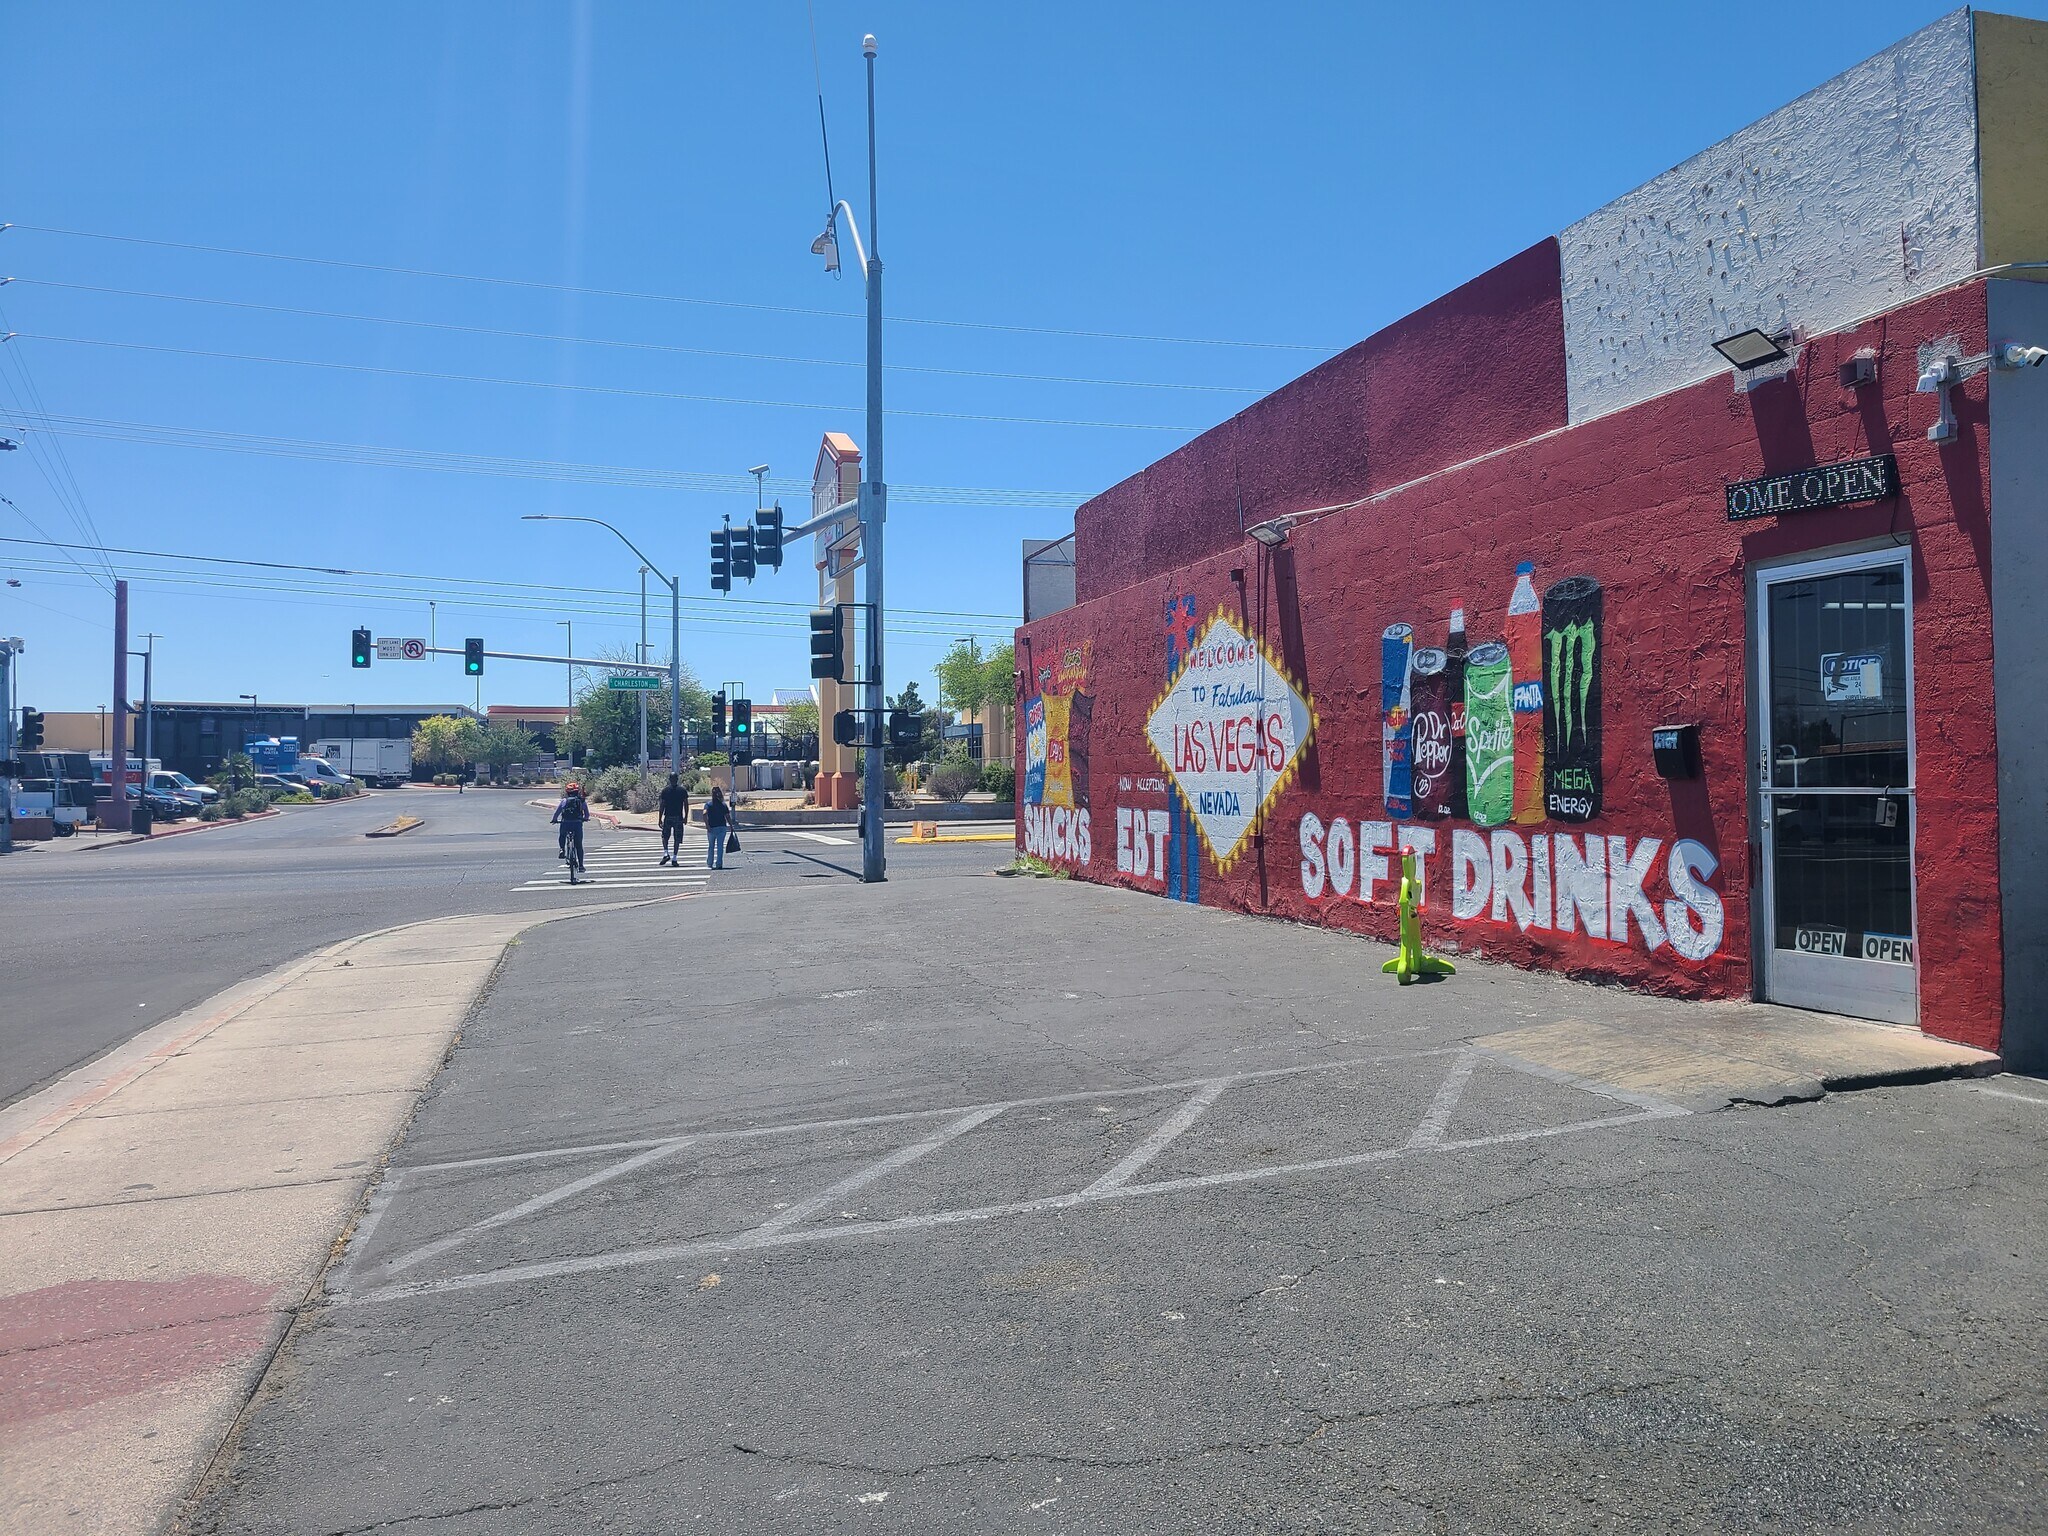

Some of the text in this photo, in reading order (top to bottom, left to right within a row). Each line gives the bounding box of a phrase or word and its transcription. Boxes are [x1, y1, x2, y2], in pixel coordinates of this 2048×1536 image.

[1732, 464, 1884, 513] OME OPEN
[1190, 644, 1255, 669] WELCOME
[613, 679, 649, 688] CHARLESTON
[1192, 686, 1206, 703] TO
[1514, 684, 1542, 711] FANTA
[1428, 711, 1447, 740] Dr
[1174, 713, 1285, 774] LAS VEGAS
[1411, 713, 1450, 769] Pepper
[1467, 716, 1512, 764] Sprite
[1119, 776, 1132, 792] NOW
[1553, 768, 1594, 793] MEGA
[1199, 791, 1241, 816] NEVADA
[1550, 794, 1593, 819] ENERGY
[1024, 803, 1092, 866] SNACKS
[1116, 806, 1170, 882] EBT
[1299, 811, 1724, 961] SOFT DRINKS
[1799, 930, 1843, 954] OPEN
[1866, 938, 1914, 962] OPEN
